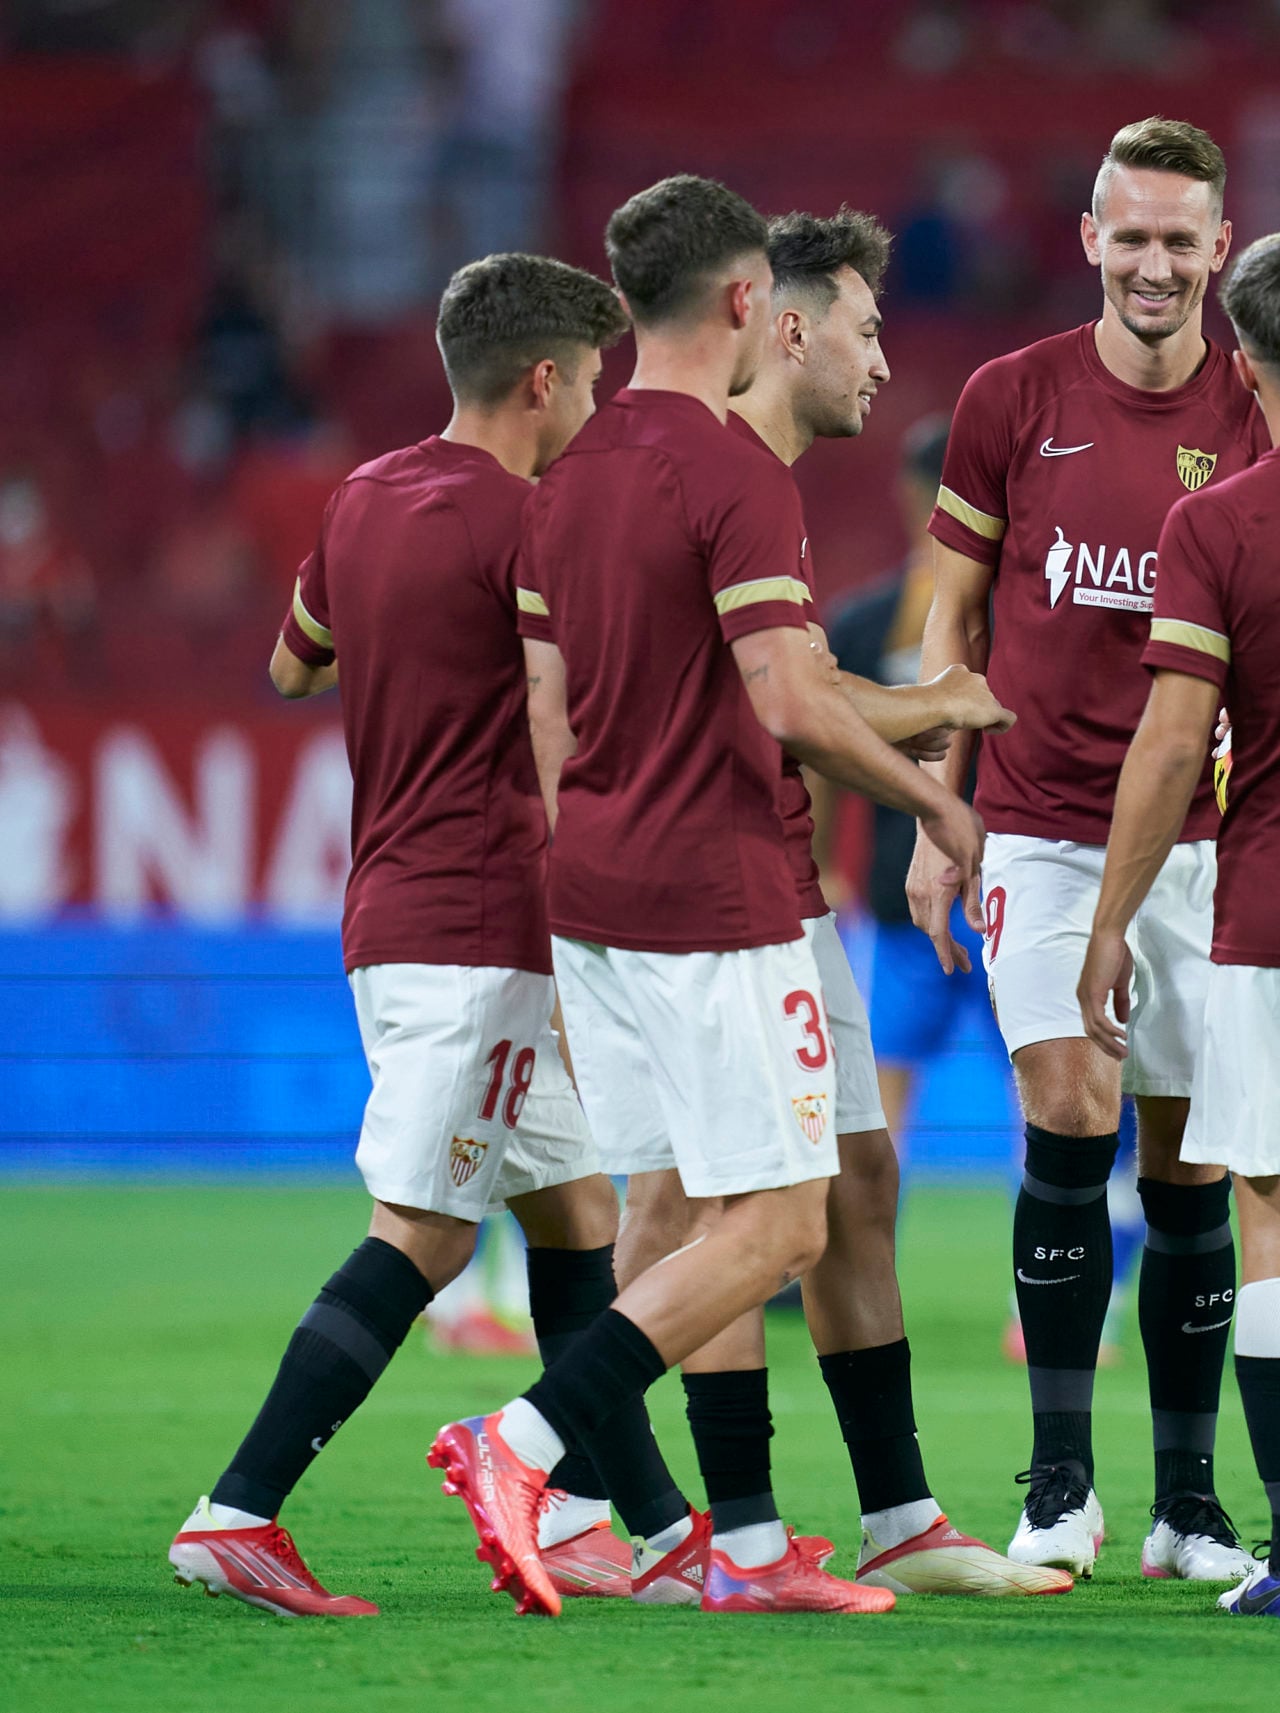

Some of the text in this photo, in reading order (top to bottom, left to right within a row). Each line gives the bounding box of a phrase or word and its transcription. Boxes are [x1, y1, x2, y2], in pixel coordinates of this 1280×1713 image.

[1074, 543, 1158, 594] NAG
[1079, 592, 1099, 602] Your
[1100, 595, 1139, 609] Investing
[781, 986, 836, 1073] 3
[477, 1039, 536, 1130] 18
[1034, 1246, 1085, 1261] SFC
[1195, 1288, 1234, 1308] SFC
[477, 1432, 496, 1502] ULTRA
